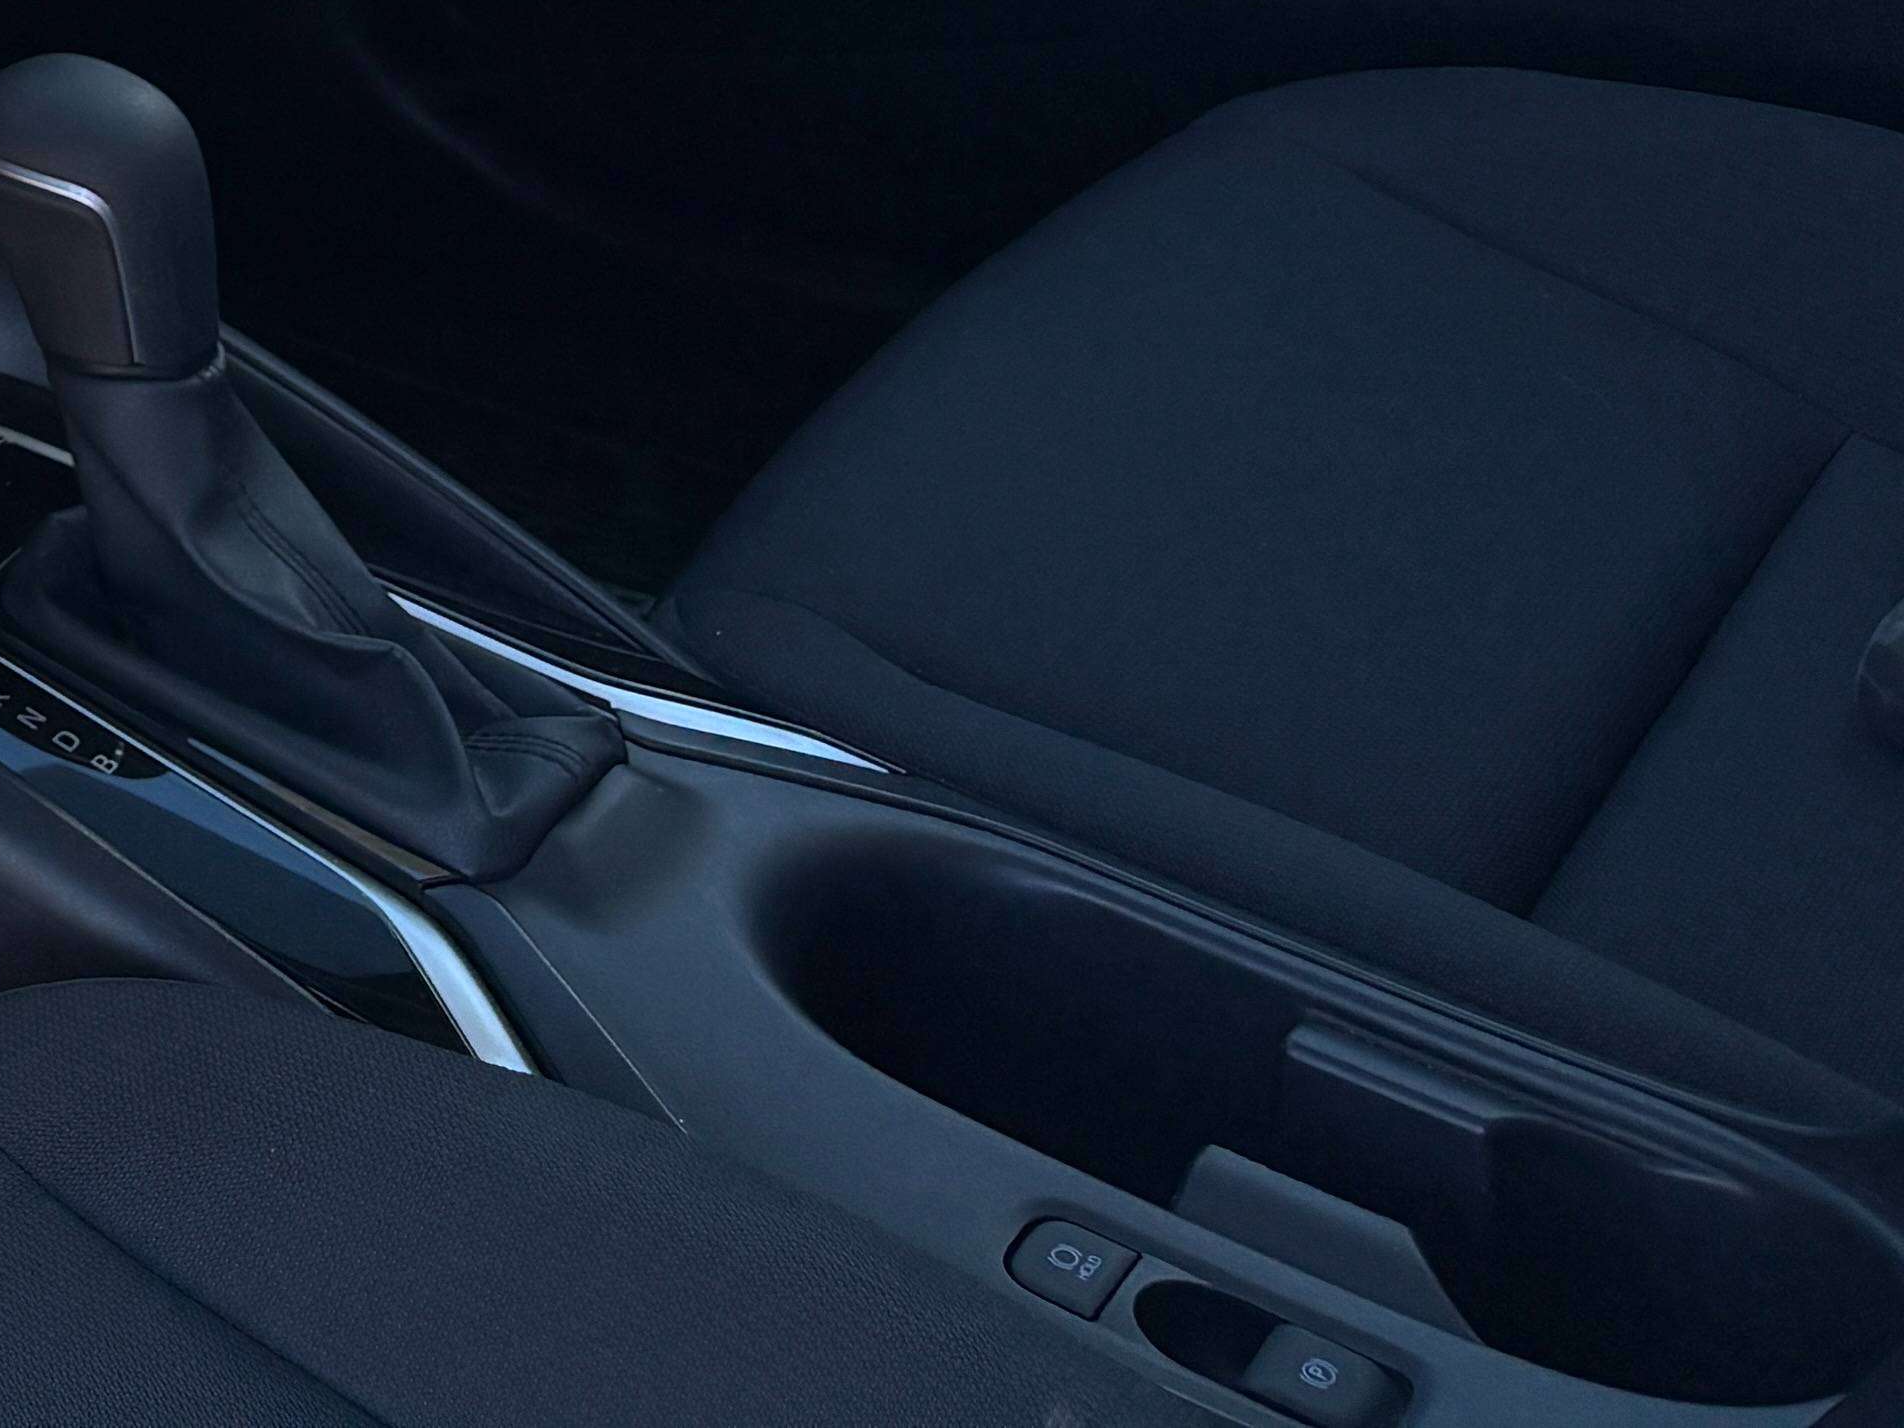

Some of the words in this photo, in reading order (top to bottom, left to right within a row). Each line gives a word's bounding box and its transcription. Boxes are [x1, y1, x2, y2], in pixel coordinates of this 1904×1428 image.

[15, 705, 48, 732] N
[51, 730, 81, 755] D
[90, 752, 120, 776] B
[1078, 1254, 1103, 1281] HOLD
